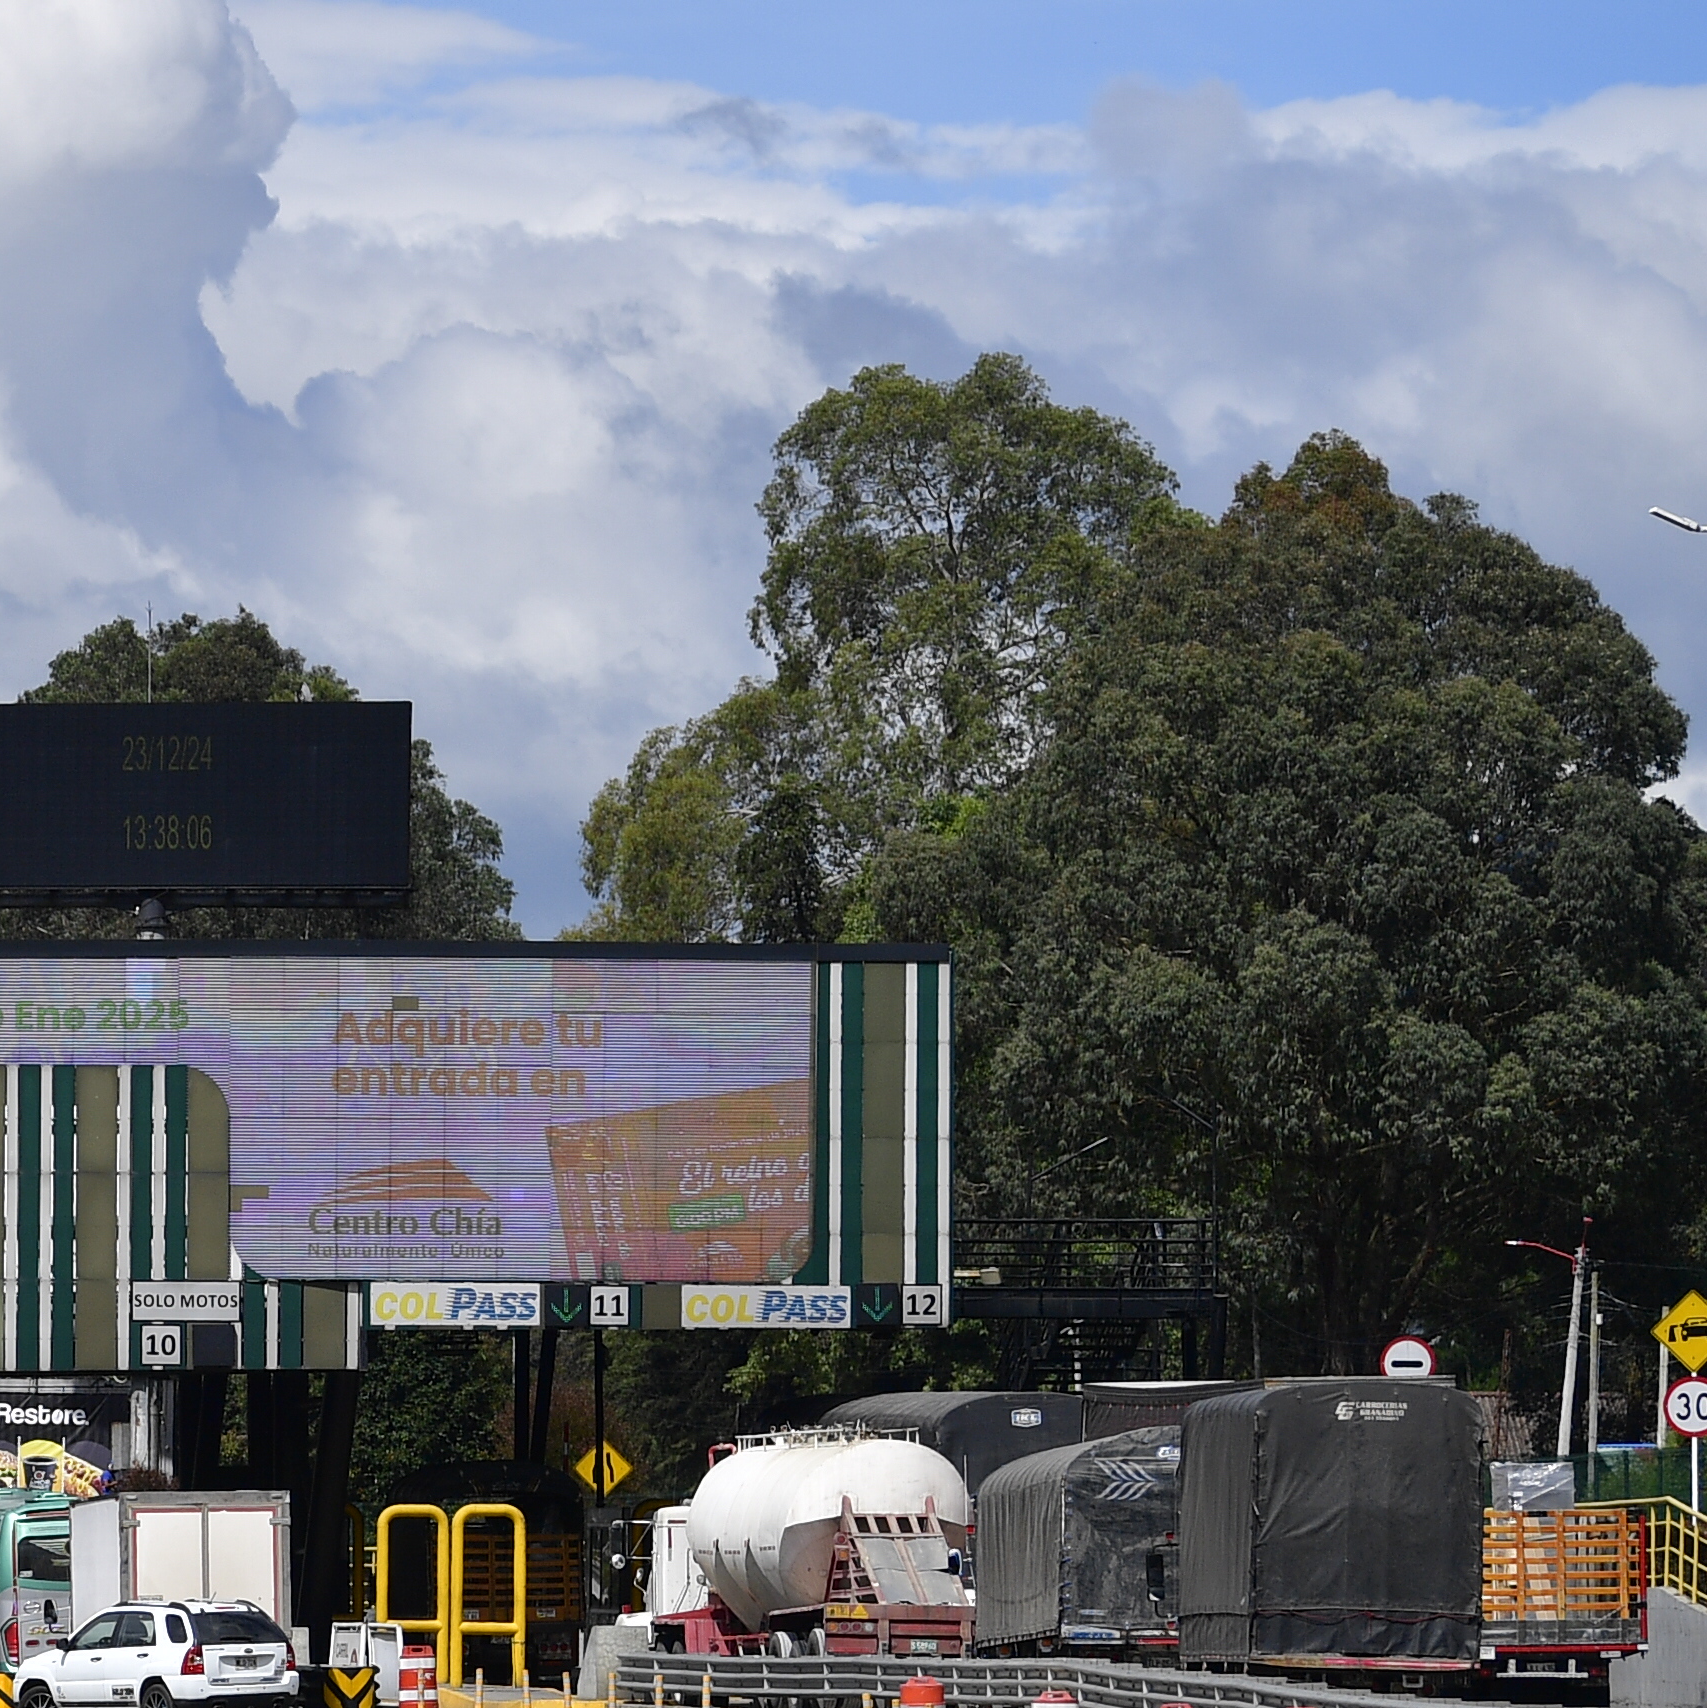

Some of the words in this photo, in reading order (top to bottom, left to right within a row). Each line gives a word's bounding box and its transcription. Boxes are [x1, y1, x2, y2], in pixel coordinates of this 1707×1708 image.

[15, 1000, 86, 1030] Ene
[95, 999, 189, 1030] 2025
[331, 1008, 545, 1057] Adquiere
[554, 1012, 604, 1048] tu
[332, 1060, 519, 1096] entrada
[530, 1068, 586, 1096] en
[308, 1207, 419, 1236] Centro
[429, 1207, 503, 1236] Chía
[133, 1291, 175, 1311] SOLO
[180, 1291, 239, 1311] MOTOS
[594, 1293, 624, 1317] 11
[906, 1293, 937, 1317] 12
[146, 1334, 177, 1357] 10
[1676, 1392, 1707, 1421] 30
